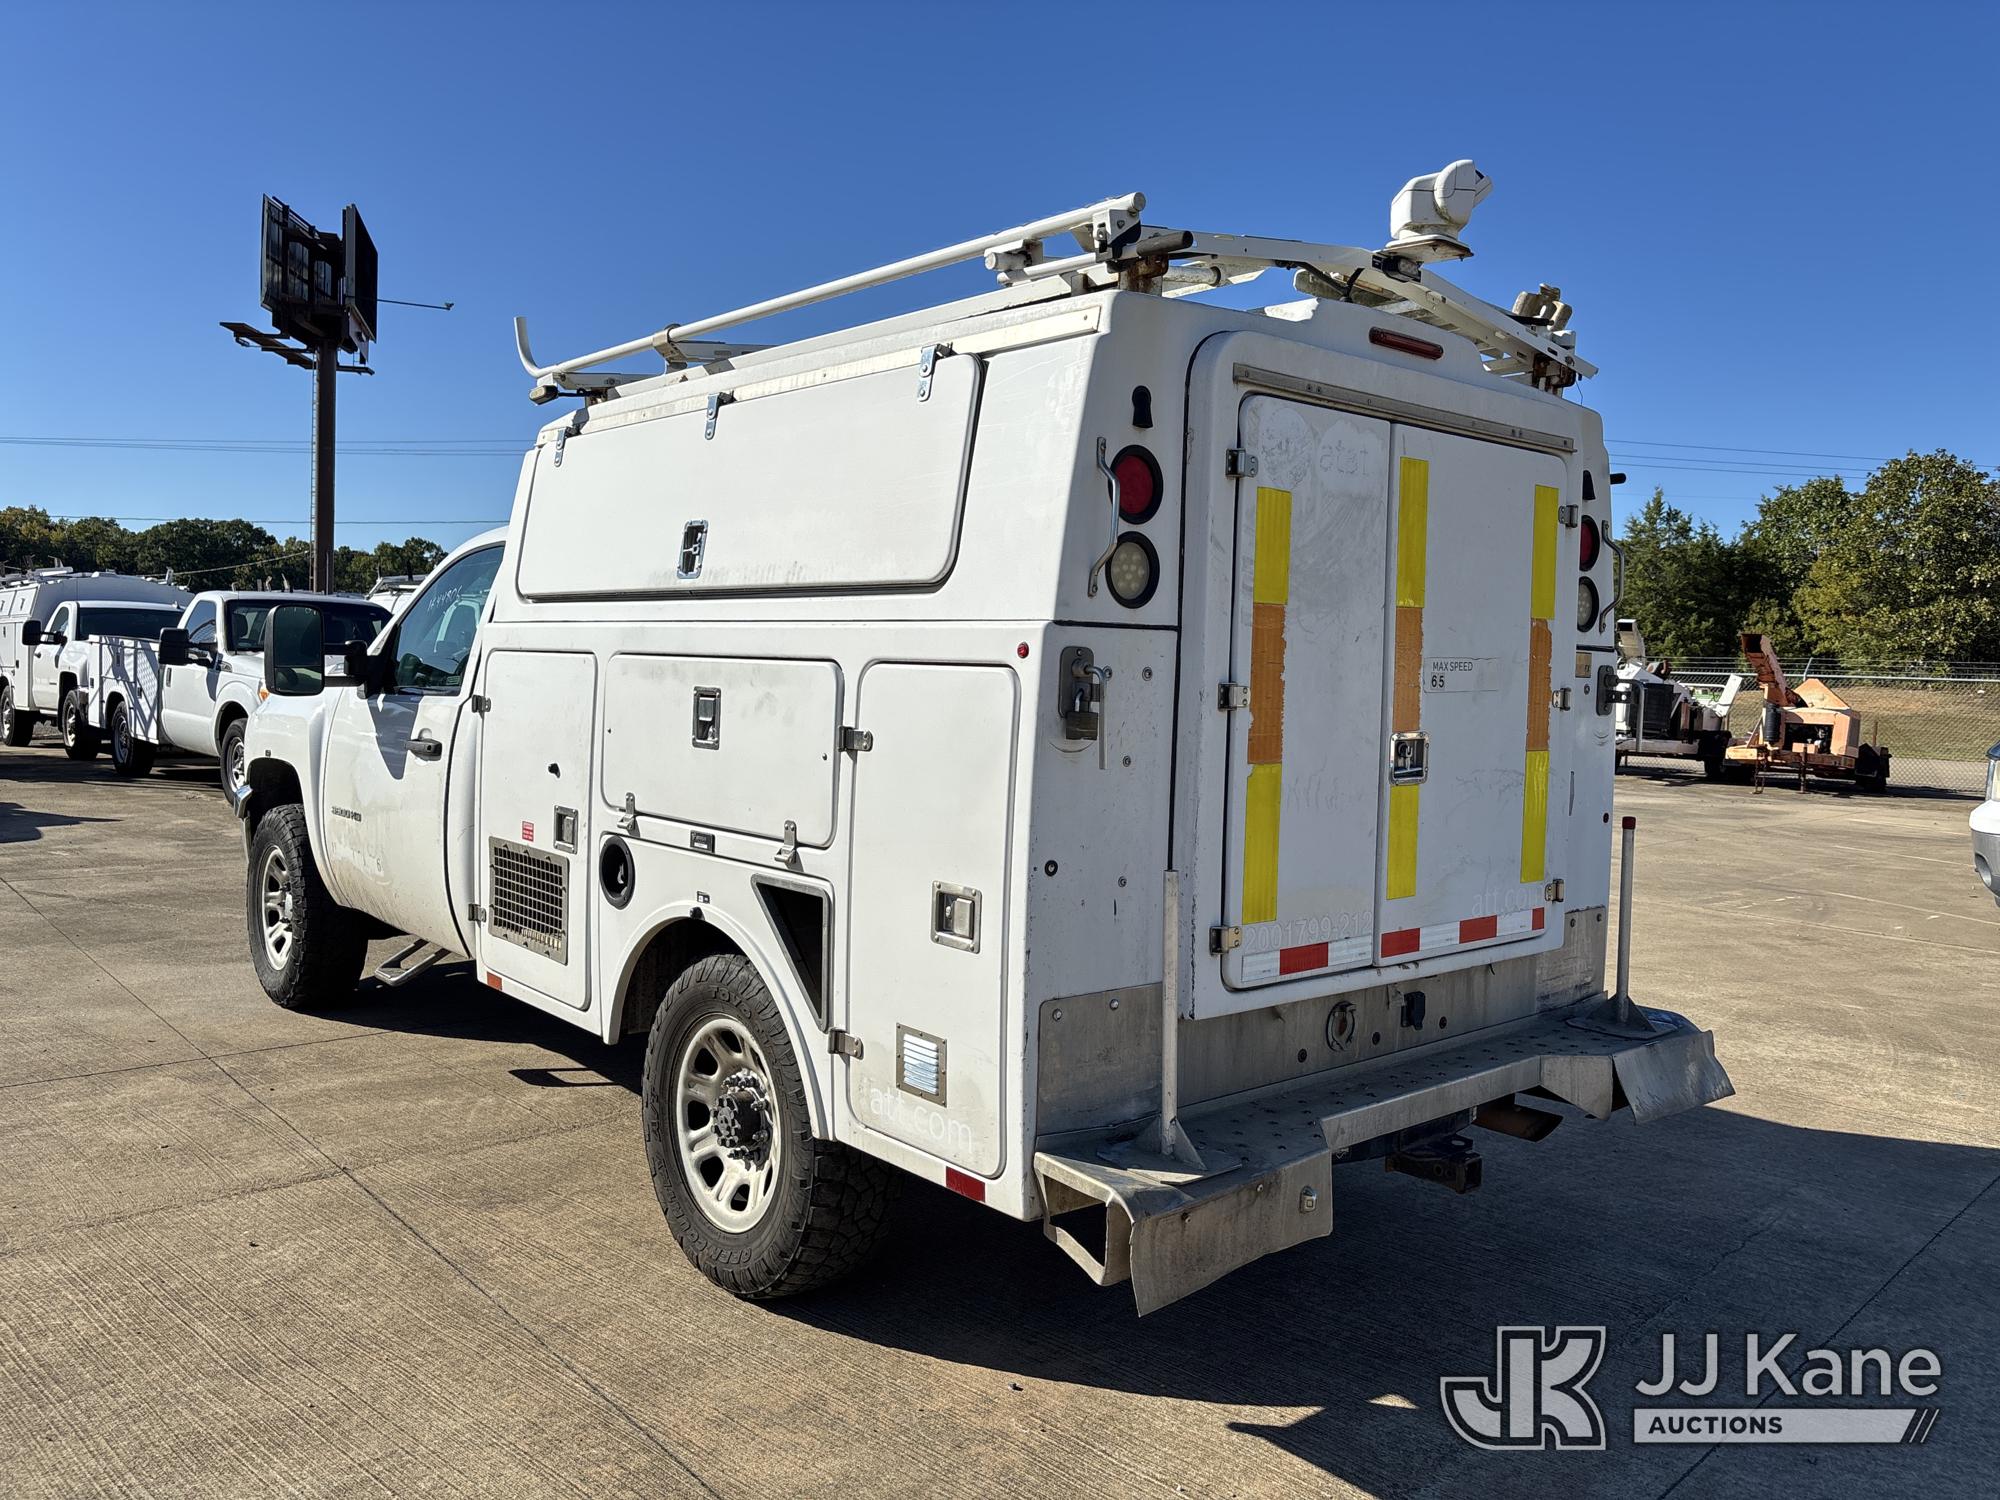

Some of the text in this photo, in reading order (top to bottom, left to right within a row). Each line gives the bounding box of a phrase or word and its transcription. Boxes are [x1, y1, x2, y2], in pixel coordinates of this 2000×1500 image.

[1432, 661, 1474, 672] MAX SPEED
[1431, 674, 1445, 688] 65
